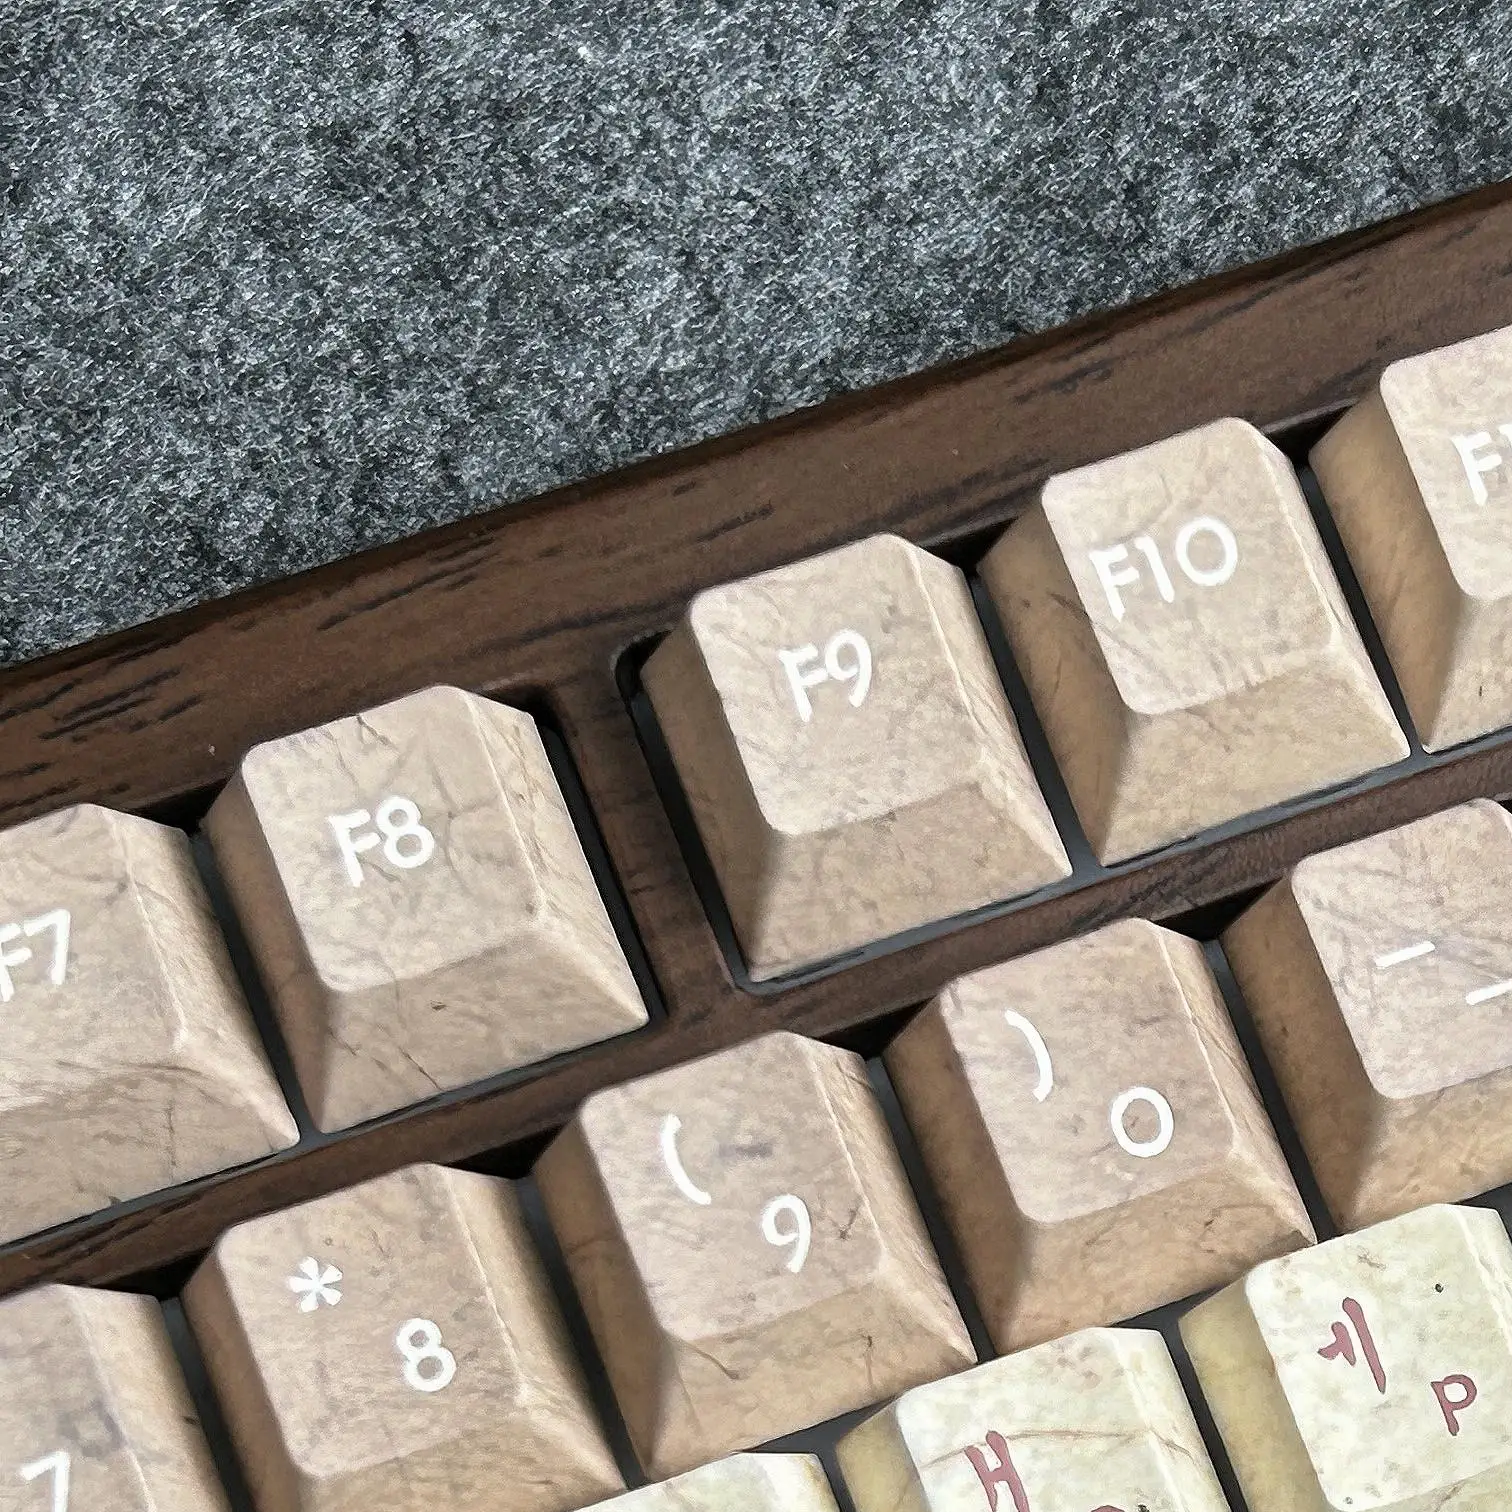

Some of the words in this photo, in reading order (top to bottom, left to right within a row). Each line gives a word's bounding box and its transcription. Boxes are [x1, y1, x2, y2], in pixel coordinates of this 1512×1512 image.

[1089, 515, 1238, 623] F10
[779, 628, 873, 722] F9
[328, 796, 435, 887] F8
[0, 909, 72, 1001] F7
[1004, 1009, 1053, 1102] )
[660, 1114, 712, 1205] (
[762, 1195, 812, 1273] 9
[397, 1318, 457, 1392] 8
[1430, 1374, 1477, 1436] P
